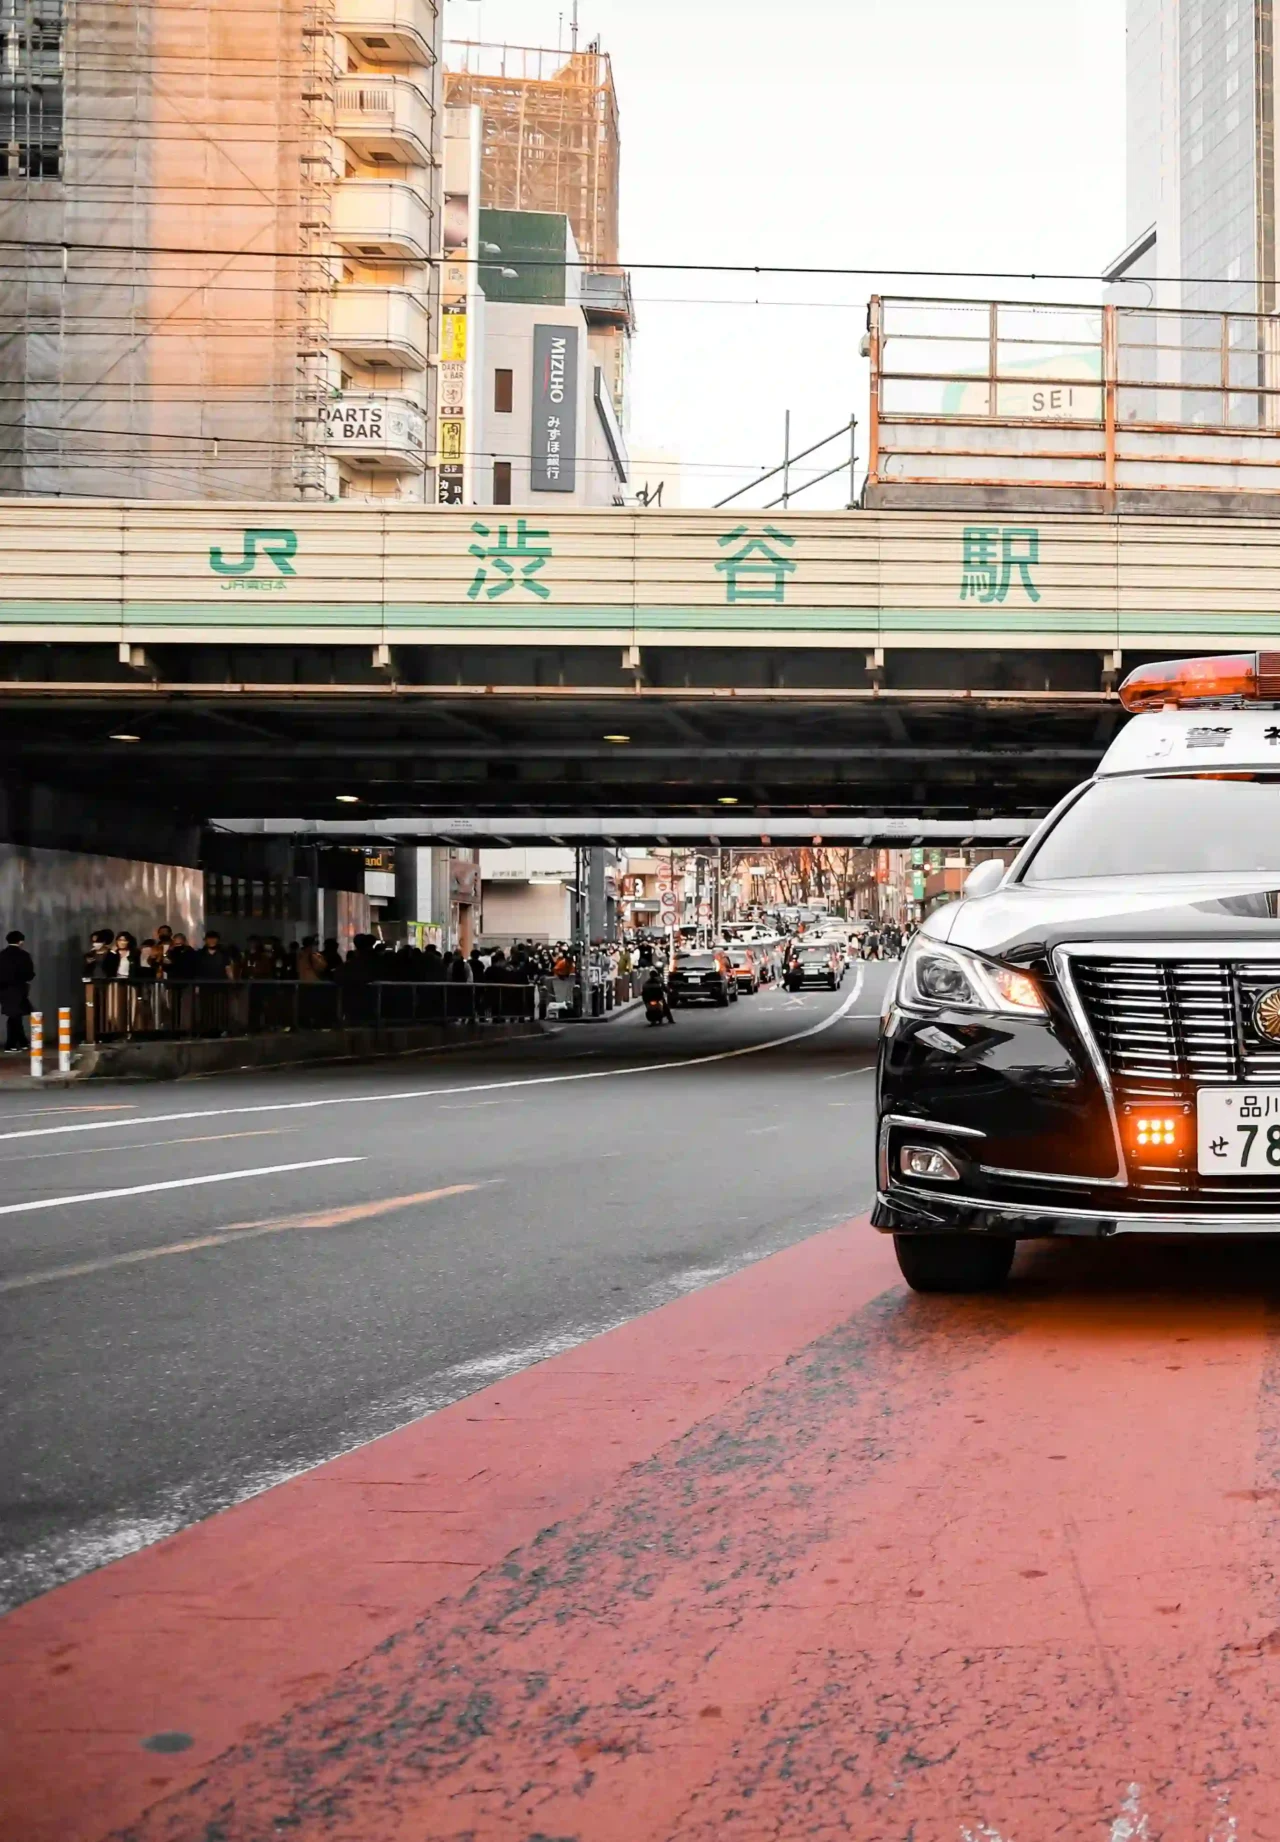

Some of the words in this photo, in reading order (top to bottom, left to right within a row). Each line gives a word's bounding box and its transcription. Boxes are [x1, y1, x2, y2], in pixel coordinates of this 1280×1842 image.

[442, 364, 464, 372] DARTS
[450, 371, 464, 379] BAR
[551, 337, 566, 403] MIZUHO
[318, 408, 383, 422] DARTS
[343, 424, 383, 438] BAR
[546, 416, 561, 480] みずほ銀行
[439, 480, 449, 505] カラ
[209, 528, 298, 574] JR
[467, 519, 1043, 603] 渋谷駅
[1209, 1136, 1230, 1158] せ
